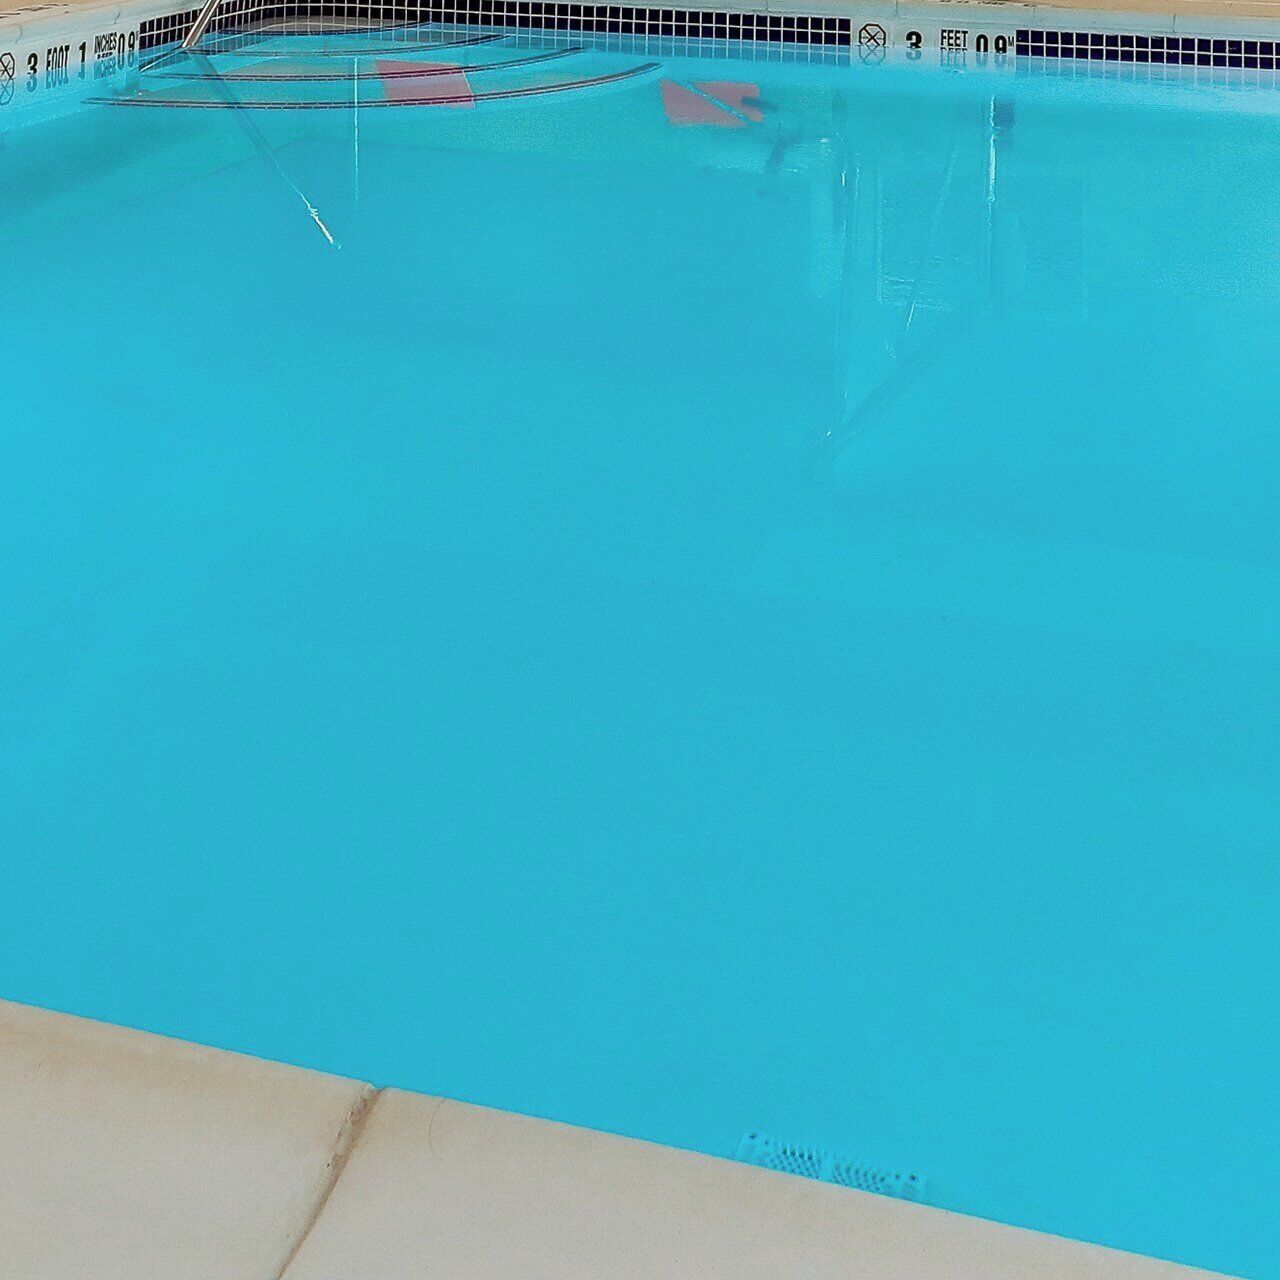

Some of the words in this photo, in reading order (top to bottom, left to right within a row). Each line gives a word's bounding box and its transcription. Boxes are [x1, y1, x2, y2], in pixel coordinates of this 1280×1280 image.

[940, 28, 969, 48] FEET
[27, 52, 39, 75] 3
[46, 44, 70, 71] FOOT
[78, 41, 87, 63] 1
